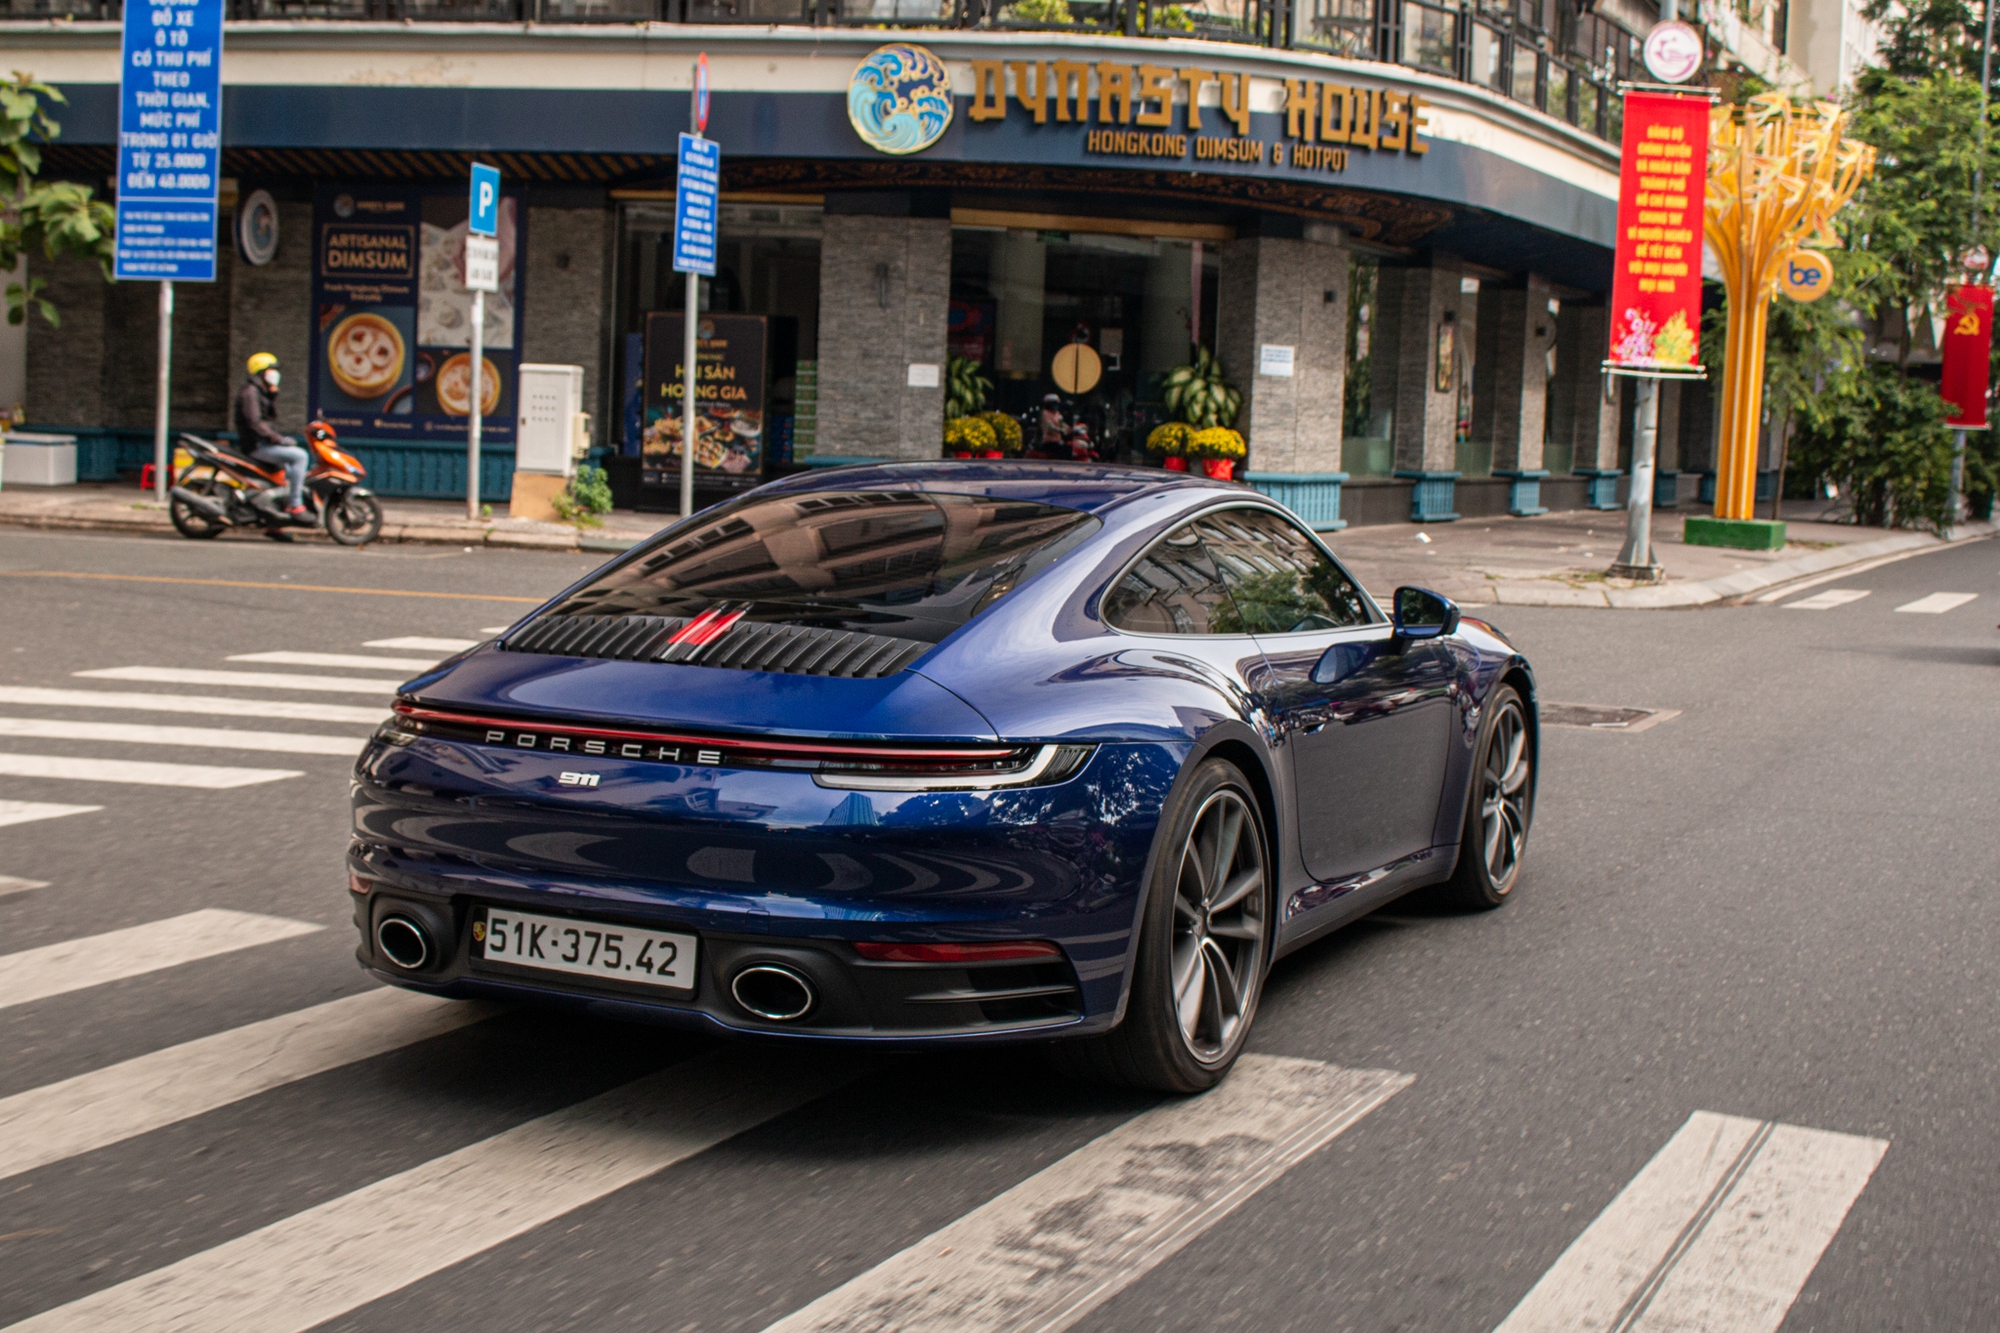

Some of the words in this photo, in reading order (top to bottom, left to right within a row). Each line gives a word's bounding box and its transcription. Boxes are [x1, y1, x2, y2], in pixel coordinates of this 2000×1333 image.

[176, 10, 193, 26] XE
[132, 48, 152, 67] CÓ
[156, 51, 183, 67] THU
[186, 48, 212, 67] PHÍ
[152, 71, 190, 87] THEO
[968, 59, 1250, 135] DYNASTY
[1284, 78, 1430, 154] HOUSE
[175, 109, 201, 128] PHÍ
[121, 131, 168, 148] TRONG
[171, 132, 188, 148] 01
[1087, 129, 1188, 158] HONGKONG
[1195, 135, 1264, 163] DIMSUM
[1272, 142, 1284, 165] &
[1293, 143, 1350, 171] HOTPOT
[479, 181, 493, 218] P
[328, 233, 407, 250] ARTISANAL
[327, 249, 407, 270] DIMSUM
[1788, 260, 1822, 286] be
[675, 363, 702, 379] HI
[704, 362, 735, 380] SẢN
[661, 382, 718, 400] HONG
[720, 384, 747, 401] GIA
[485, 730, 721, 765] PORSCHE
[558, 771, 600, 787] 911
